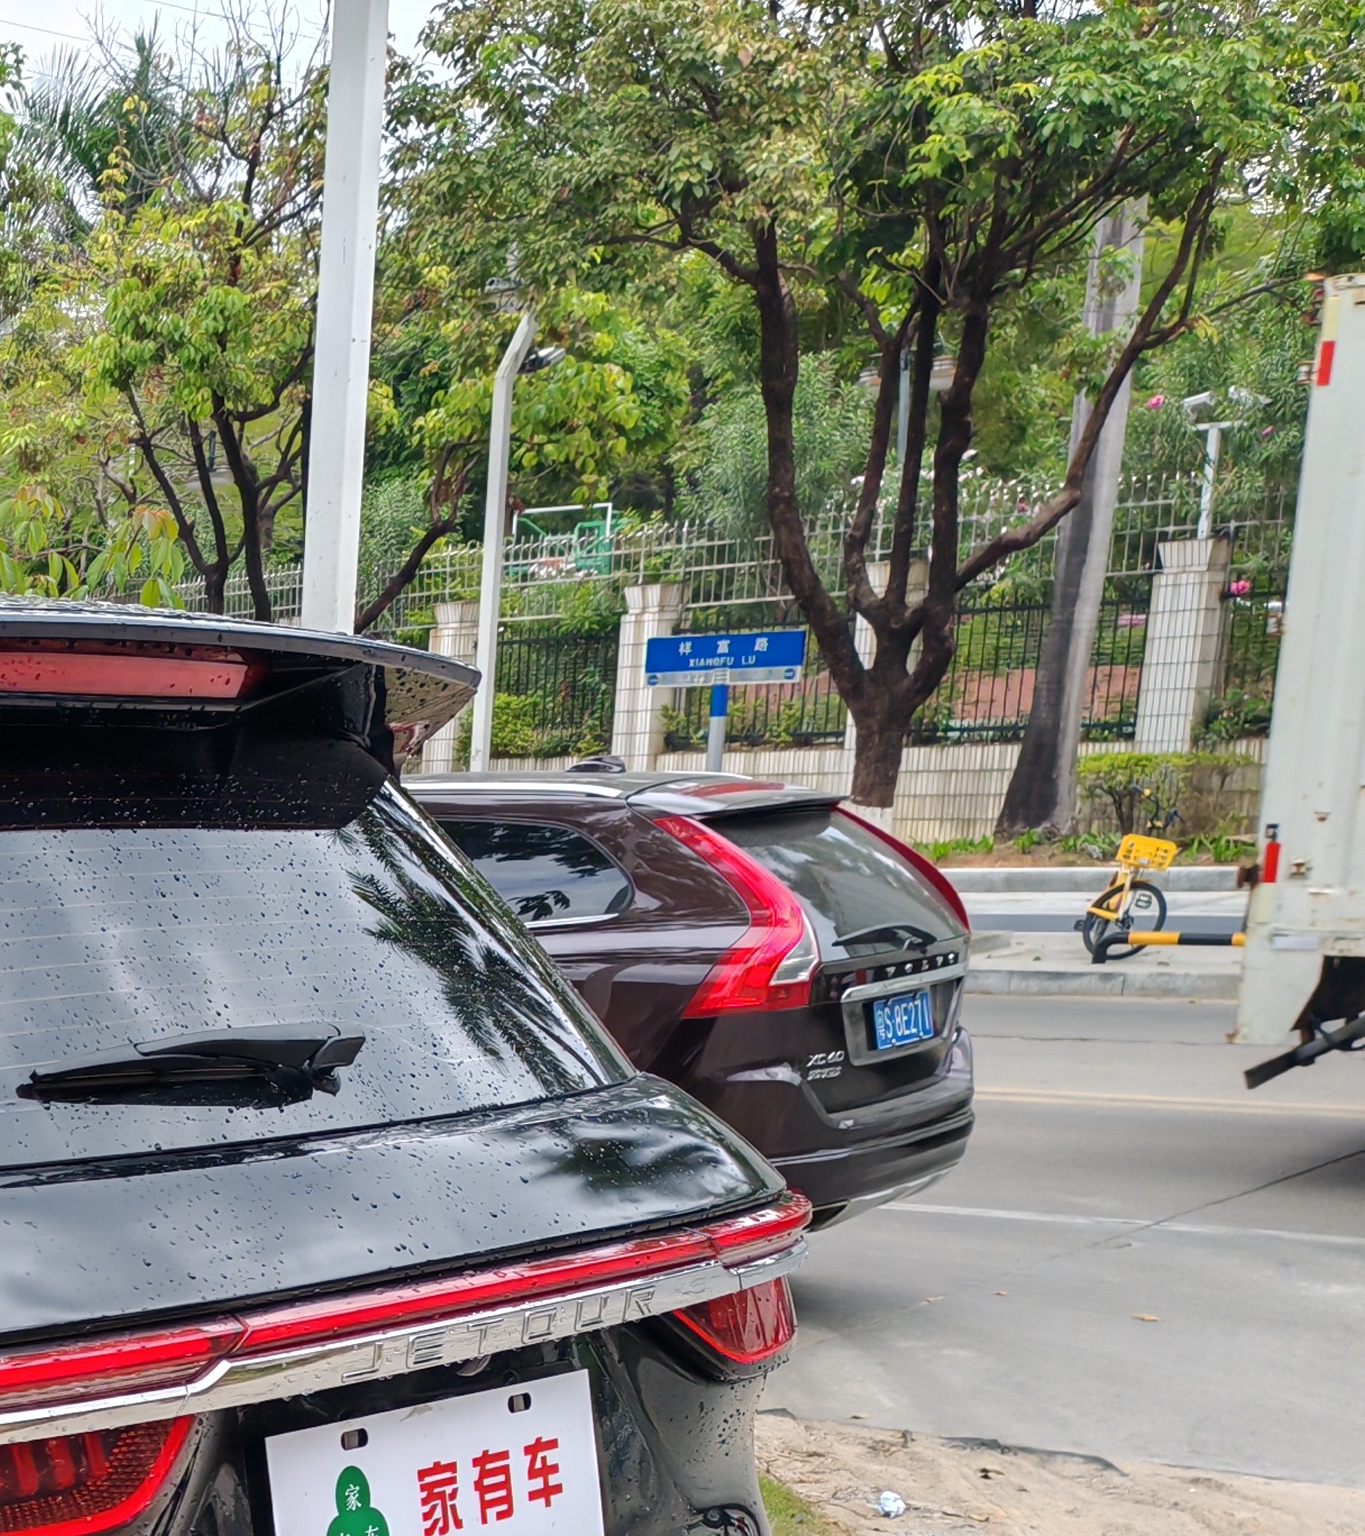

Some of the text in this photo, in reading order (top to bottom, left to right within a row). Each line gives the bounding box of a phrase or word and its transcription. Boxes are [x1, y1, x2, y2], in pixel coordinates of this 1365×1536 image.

[678, 637, 769, 656] 祥富路
[741, 655, 756, 666] LU
[341, 1285, 656, 1384] JETOUR
